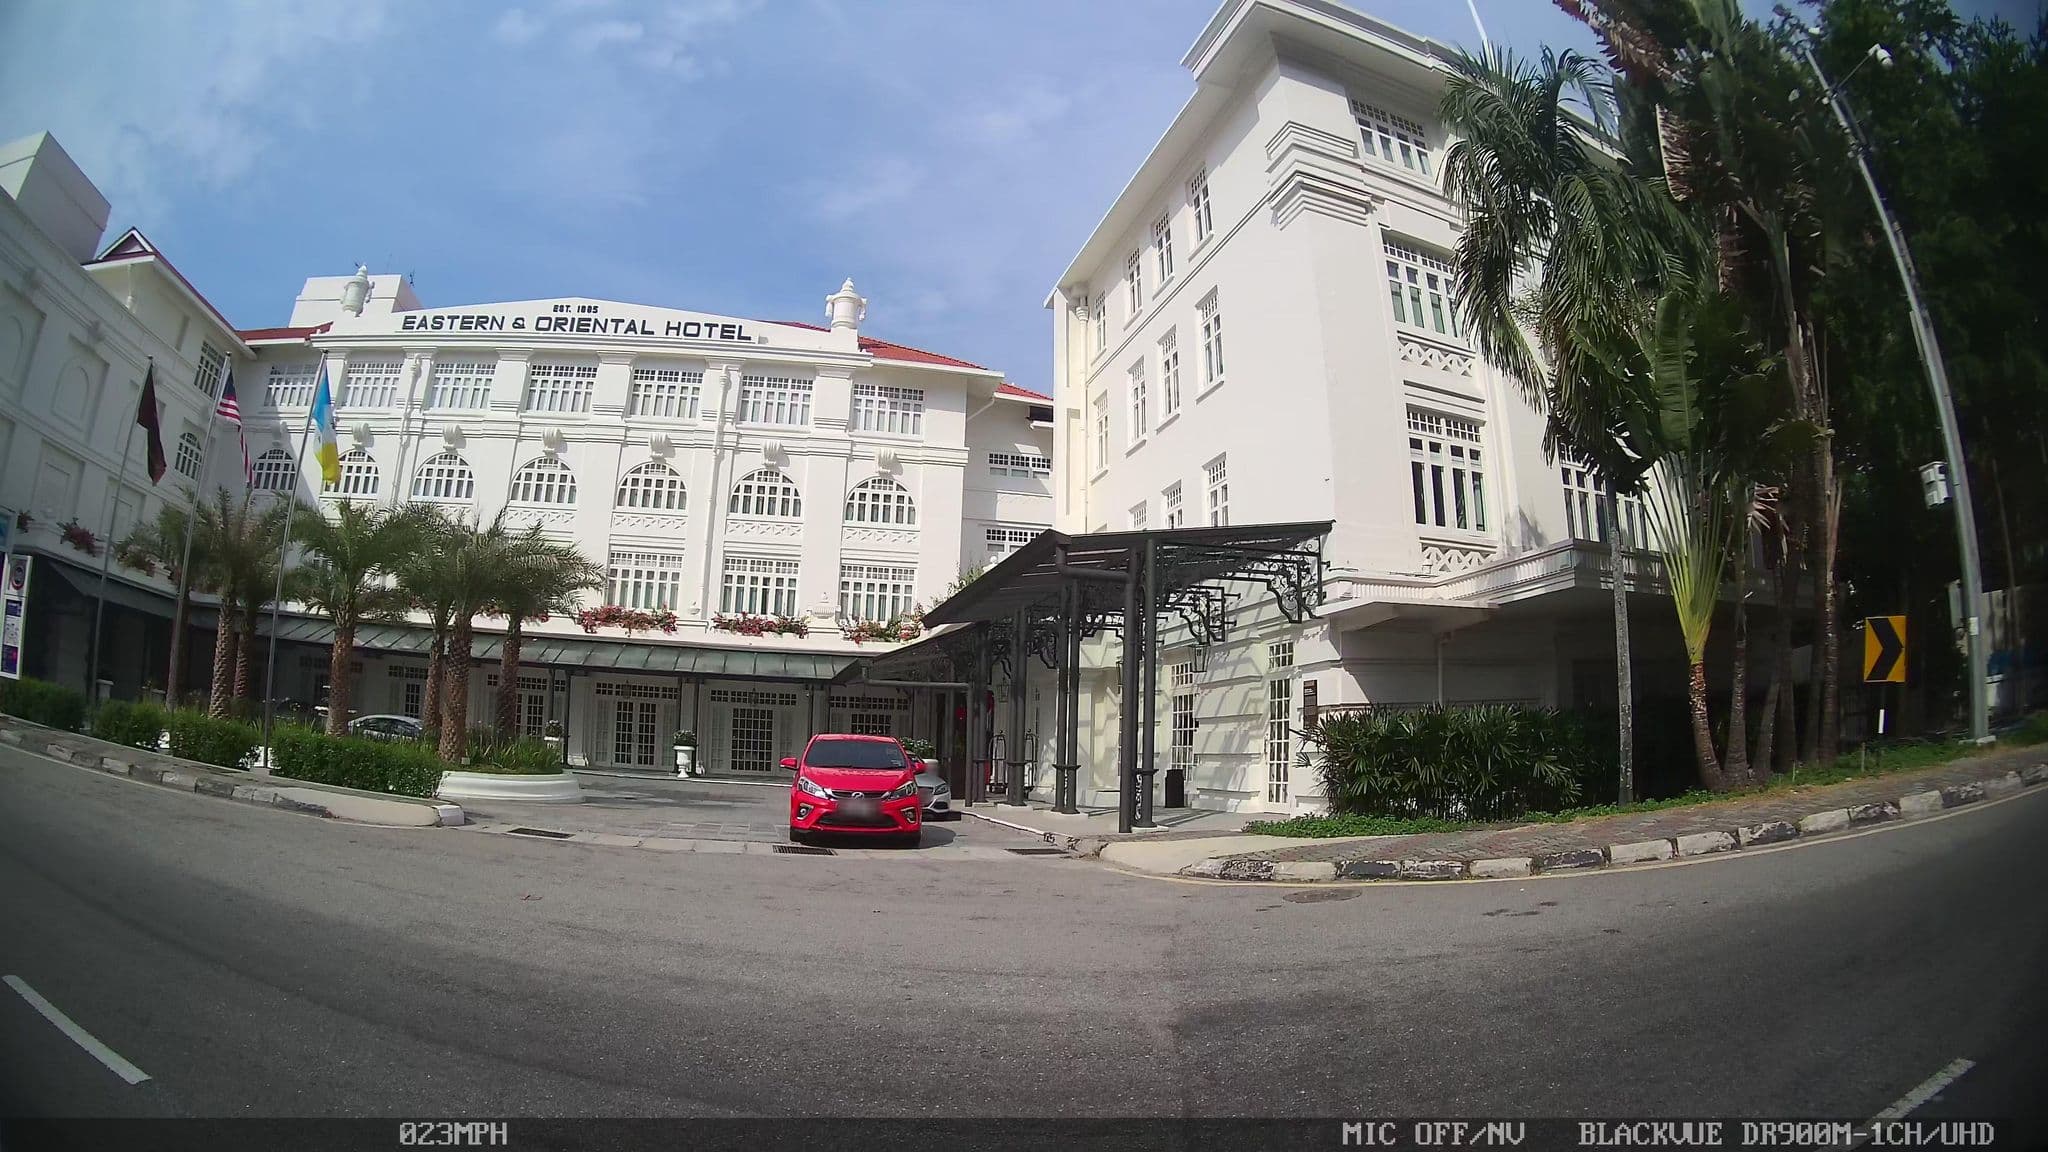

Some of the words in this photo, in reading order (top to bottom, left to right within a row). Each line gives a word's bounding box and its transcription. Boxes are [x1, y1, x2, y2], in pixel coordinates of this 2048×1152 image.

[552, 304, 572, 313] EST.
[402, 315, 505, 331] EASTERN
[511, 317, 526, 330] &
[534, 316, 655, 335] ORIENTAL
[665, 320, 752, 341] HOTEL
